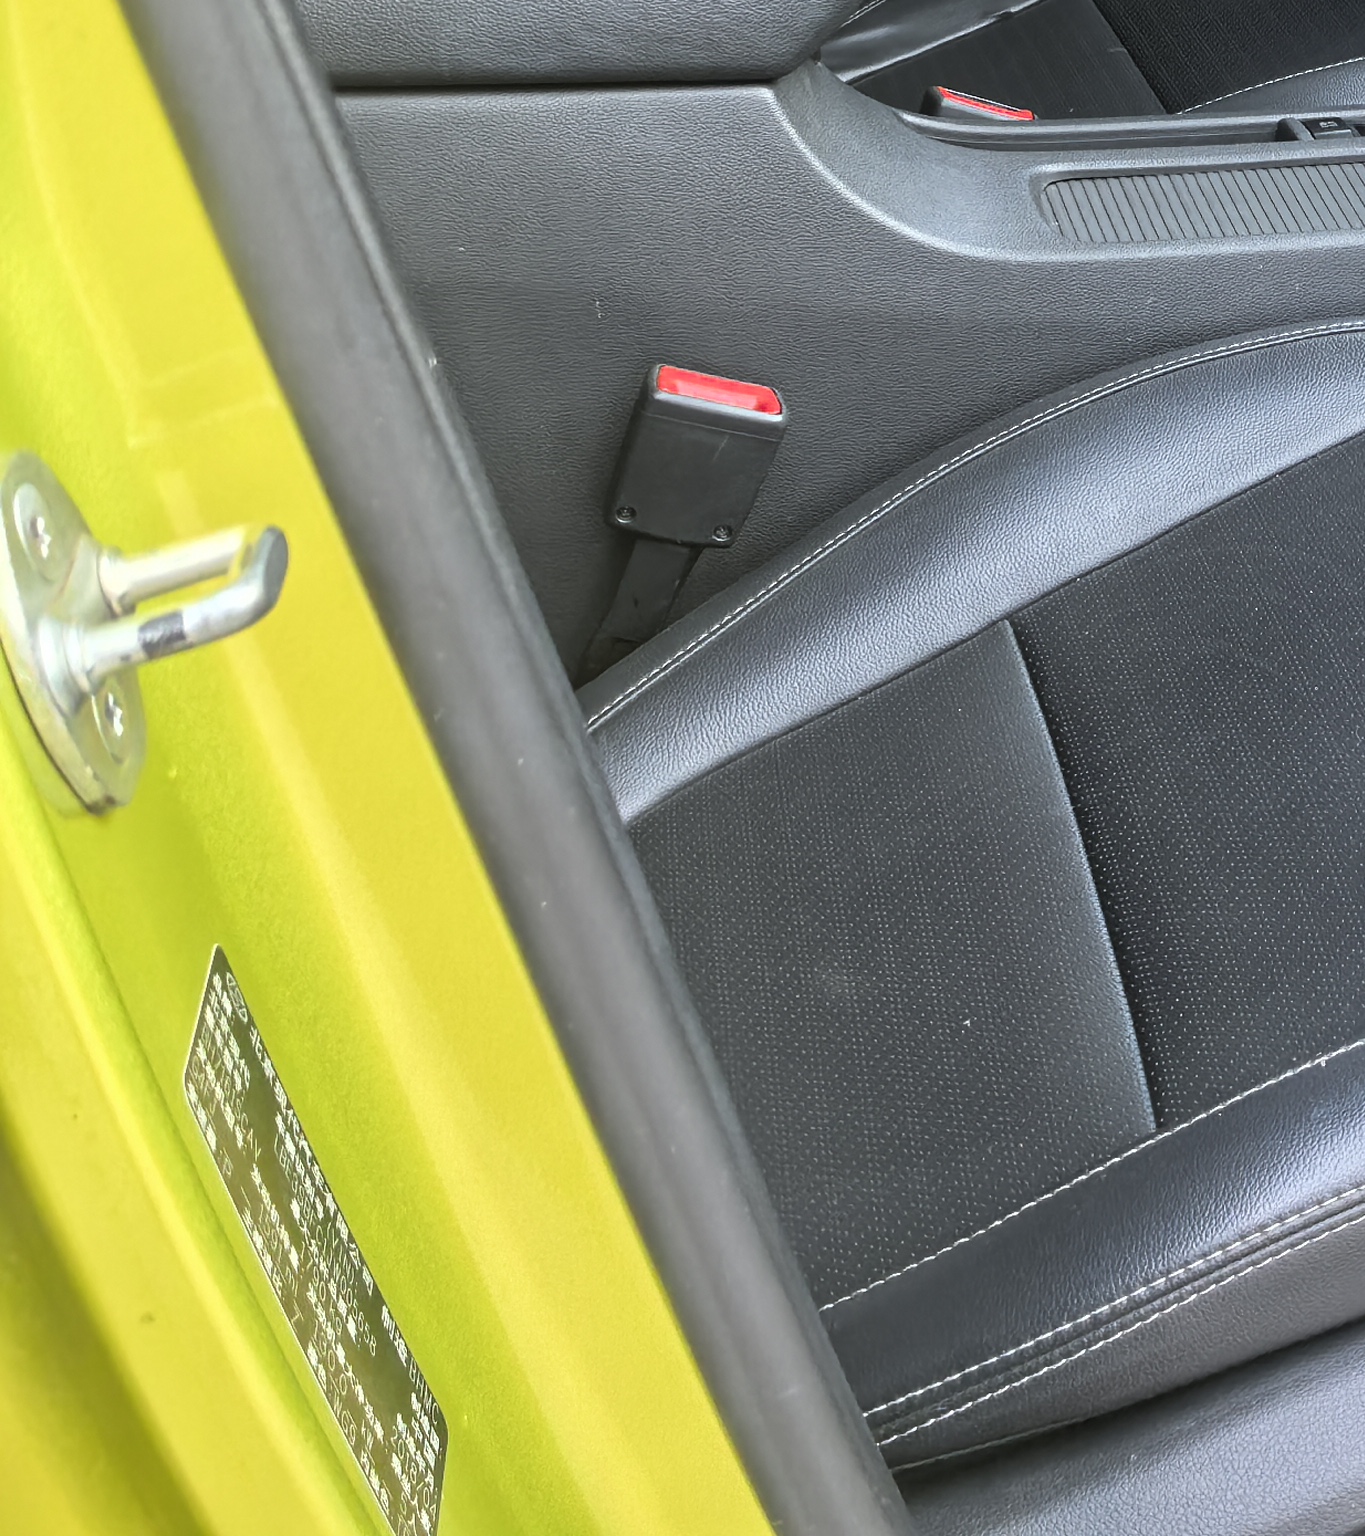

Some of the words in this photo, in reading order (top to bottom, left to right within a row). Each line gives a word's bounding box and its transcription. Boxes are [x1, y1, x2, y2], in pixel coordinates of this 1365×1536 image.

[191, 1055, 217, 1115] G4FJ
[250, 1027, 372, 1294] 北京现代汽车有限公司
[408, 1357, 438, 1425] BHMC
[258, 1203, 282, 1263] 1591
[300, 1241, 326, 1304] 1790
[313, 1319, 347, 1395] 130.0
[390, 1425, 436, 1521] 2018/04
[411, 1417, 435, 1470] 中国
